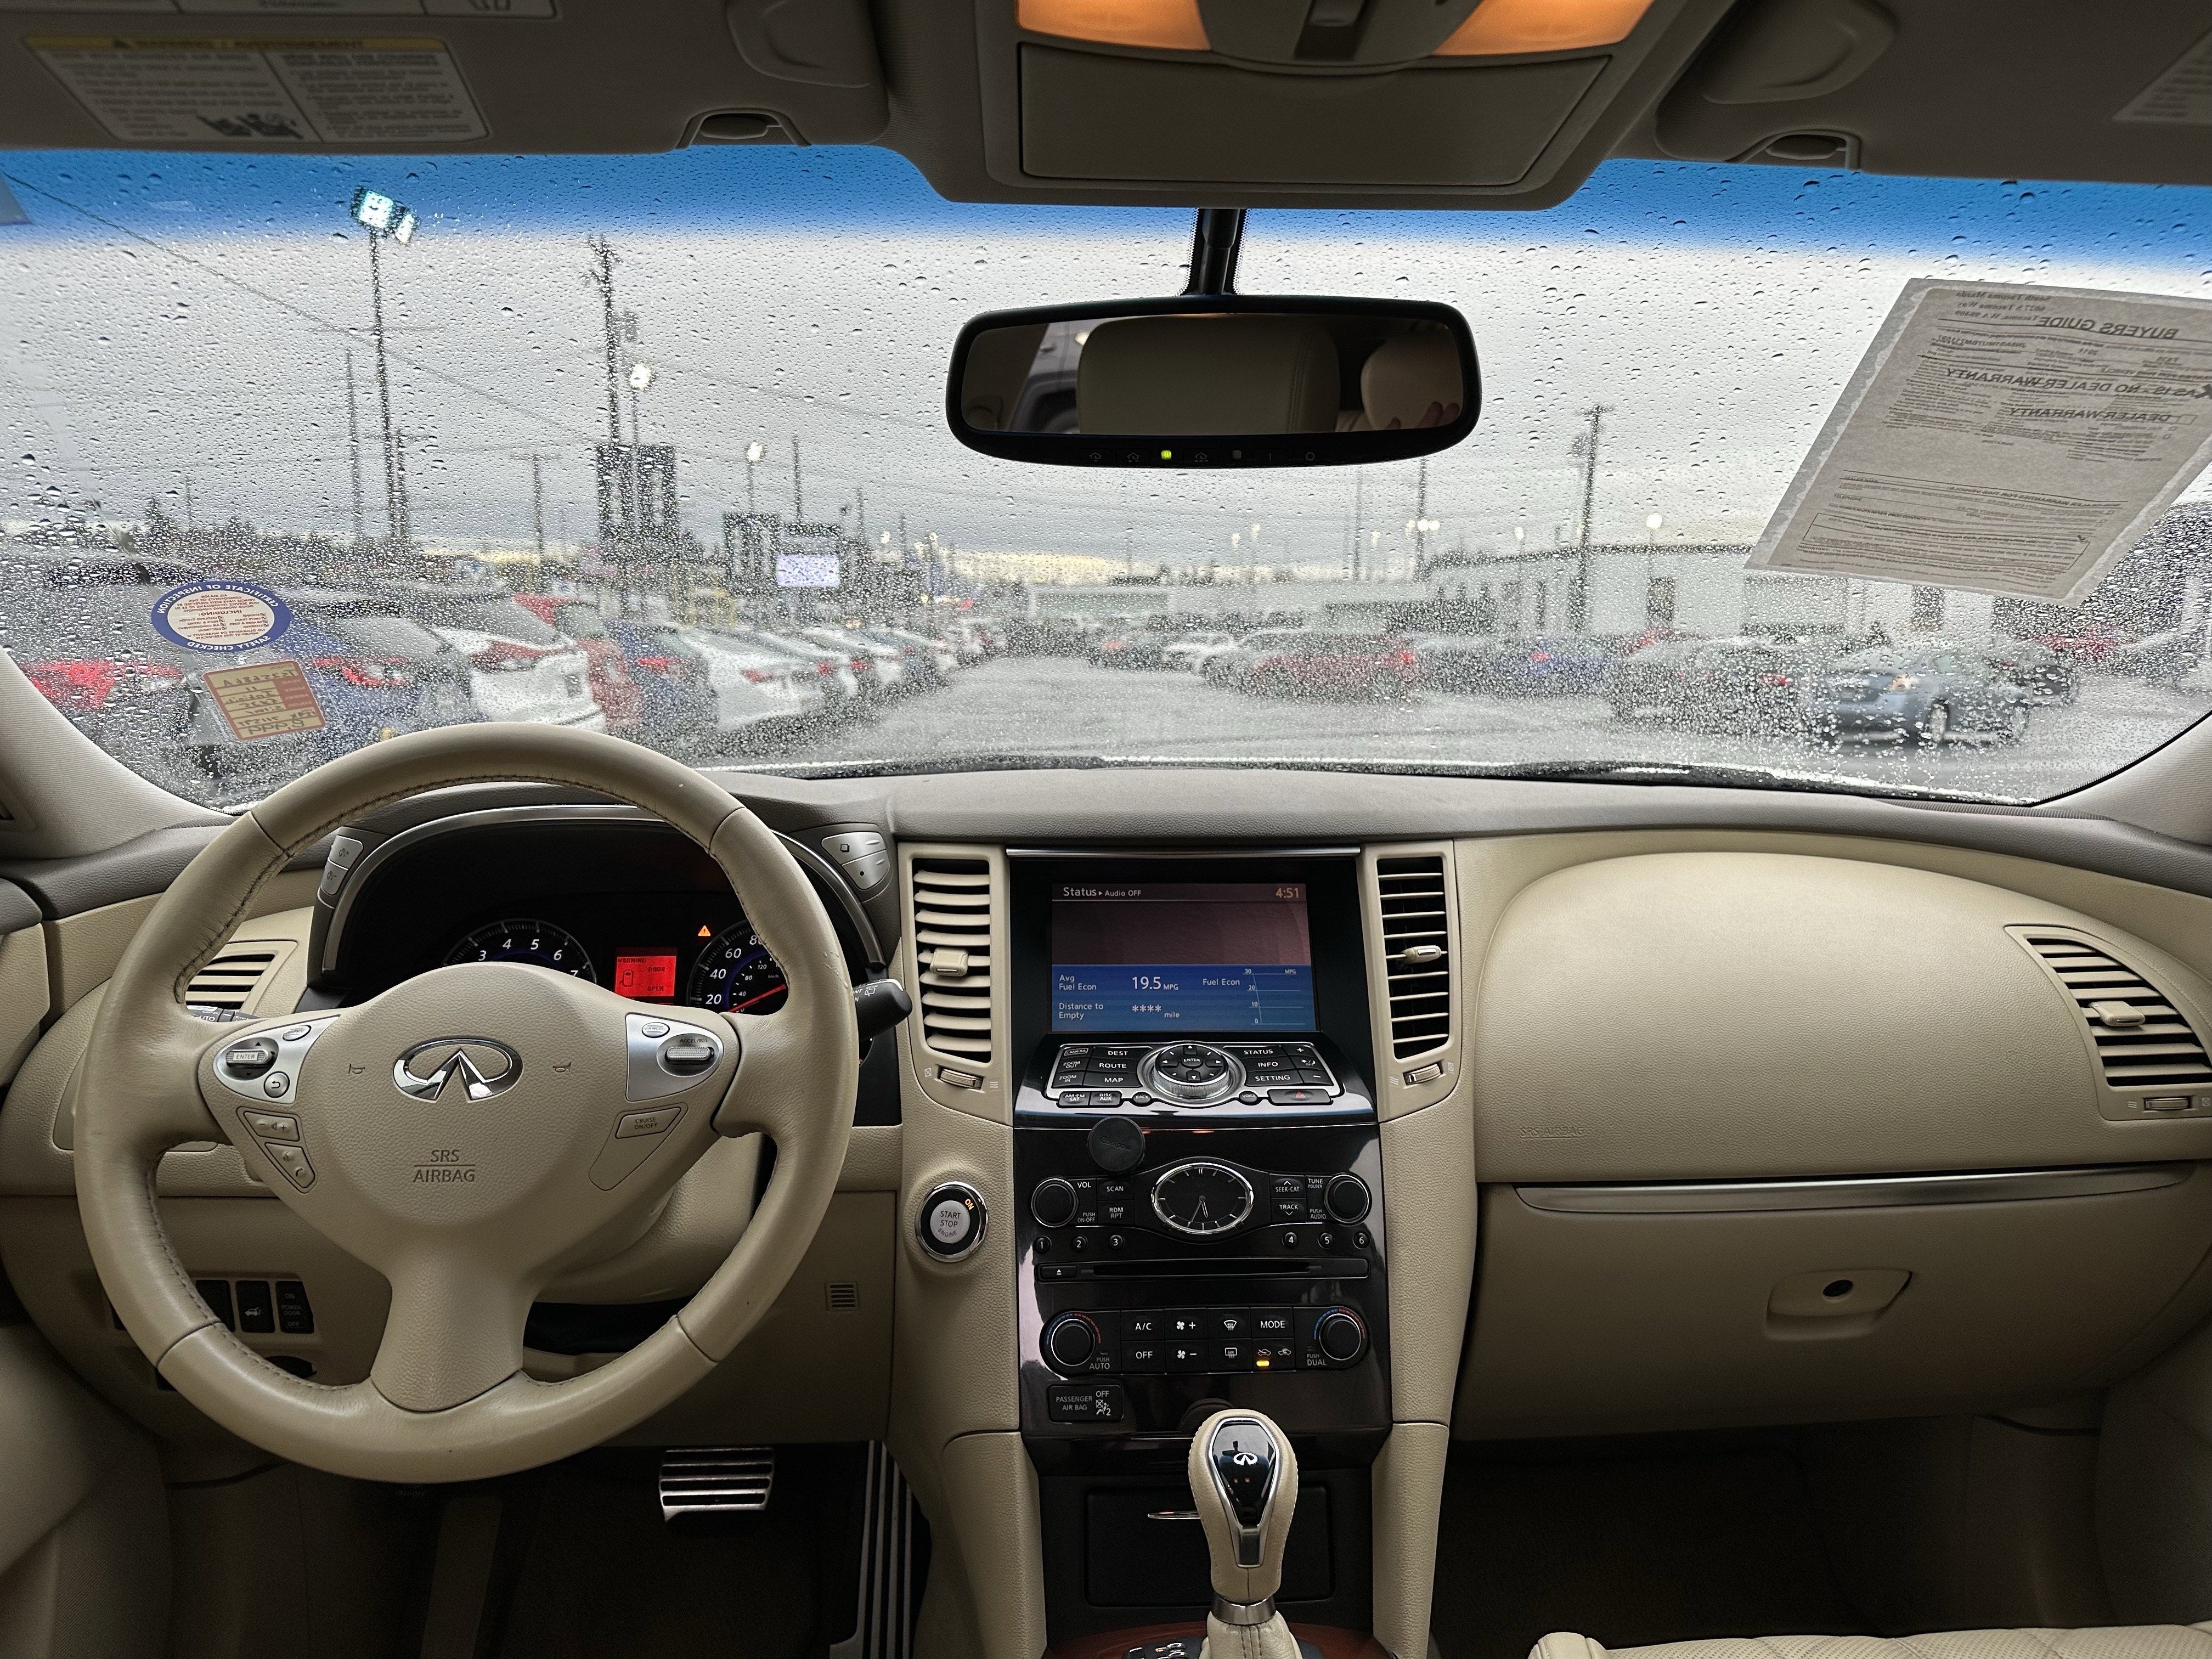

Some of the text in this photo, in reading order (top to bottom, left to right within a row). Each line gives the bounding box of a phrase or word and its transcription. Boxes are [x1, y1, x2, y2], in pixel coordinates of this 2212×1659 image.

[1063, 887, 1097, 896] Status
[1276, 888, 1299, 898] 4:51
[503, 939, 512, 949] 4
[531, 939, 539, 950] 5
[478, 950, 486, 961] 3
[554, 950, 562, 960] 6
[725, 948, 741, 958] 60
[710, 969, 726, 979] 40
[1059, 974, 1075, 983] Avg
[1132, 977, 1161, 989] 19.5
[706, 994, 721, 1005] 20
[1059, 1012, 1084, 1020] Empty
[431, 1149, 460, 1162] SRS
[413, 1169, 475, 1183] AIRBAG
[964, 1199, 974, 1210] ON
[940, 1211, 961, 1219] START
[938, 1228, 957, 1237] ENGINE
